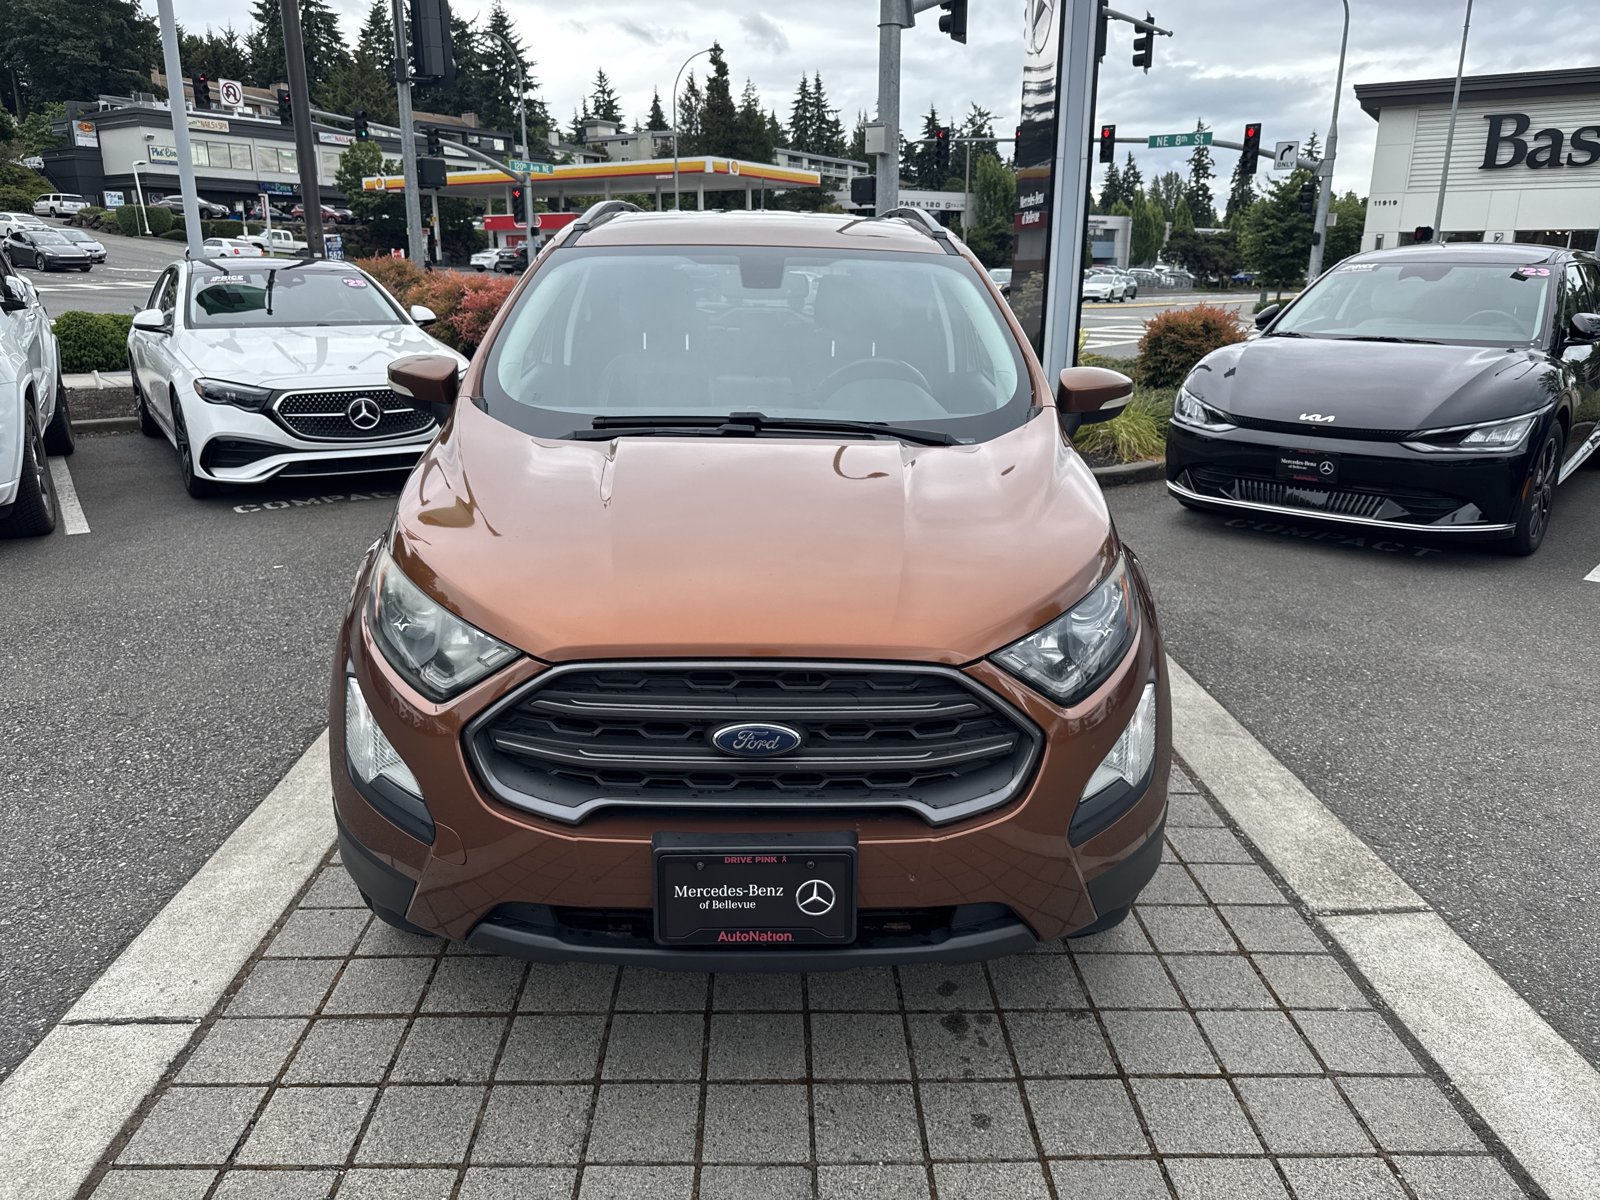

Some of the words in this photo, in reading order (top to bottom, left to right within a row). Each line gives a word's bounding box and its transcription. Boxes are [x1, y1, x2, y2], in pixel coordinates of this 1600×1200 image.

[1156, 136, 1168, 147] NE
[1175, 135, 1188, 145] 8th
[1194, 134, 1204, 145] St
[1478, 113, 1600, 170] Bas
[732, 729, 779, 750] Ford
[724, 856, 753, 864] DRIVE
[673, 884, 784, 898] Mercedes-Benz
[699, 900, 709, 910] of
[712, 900, 756, 909] Bellevue
[717, 930, 793, 942] AutoNation
